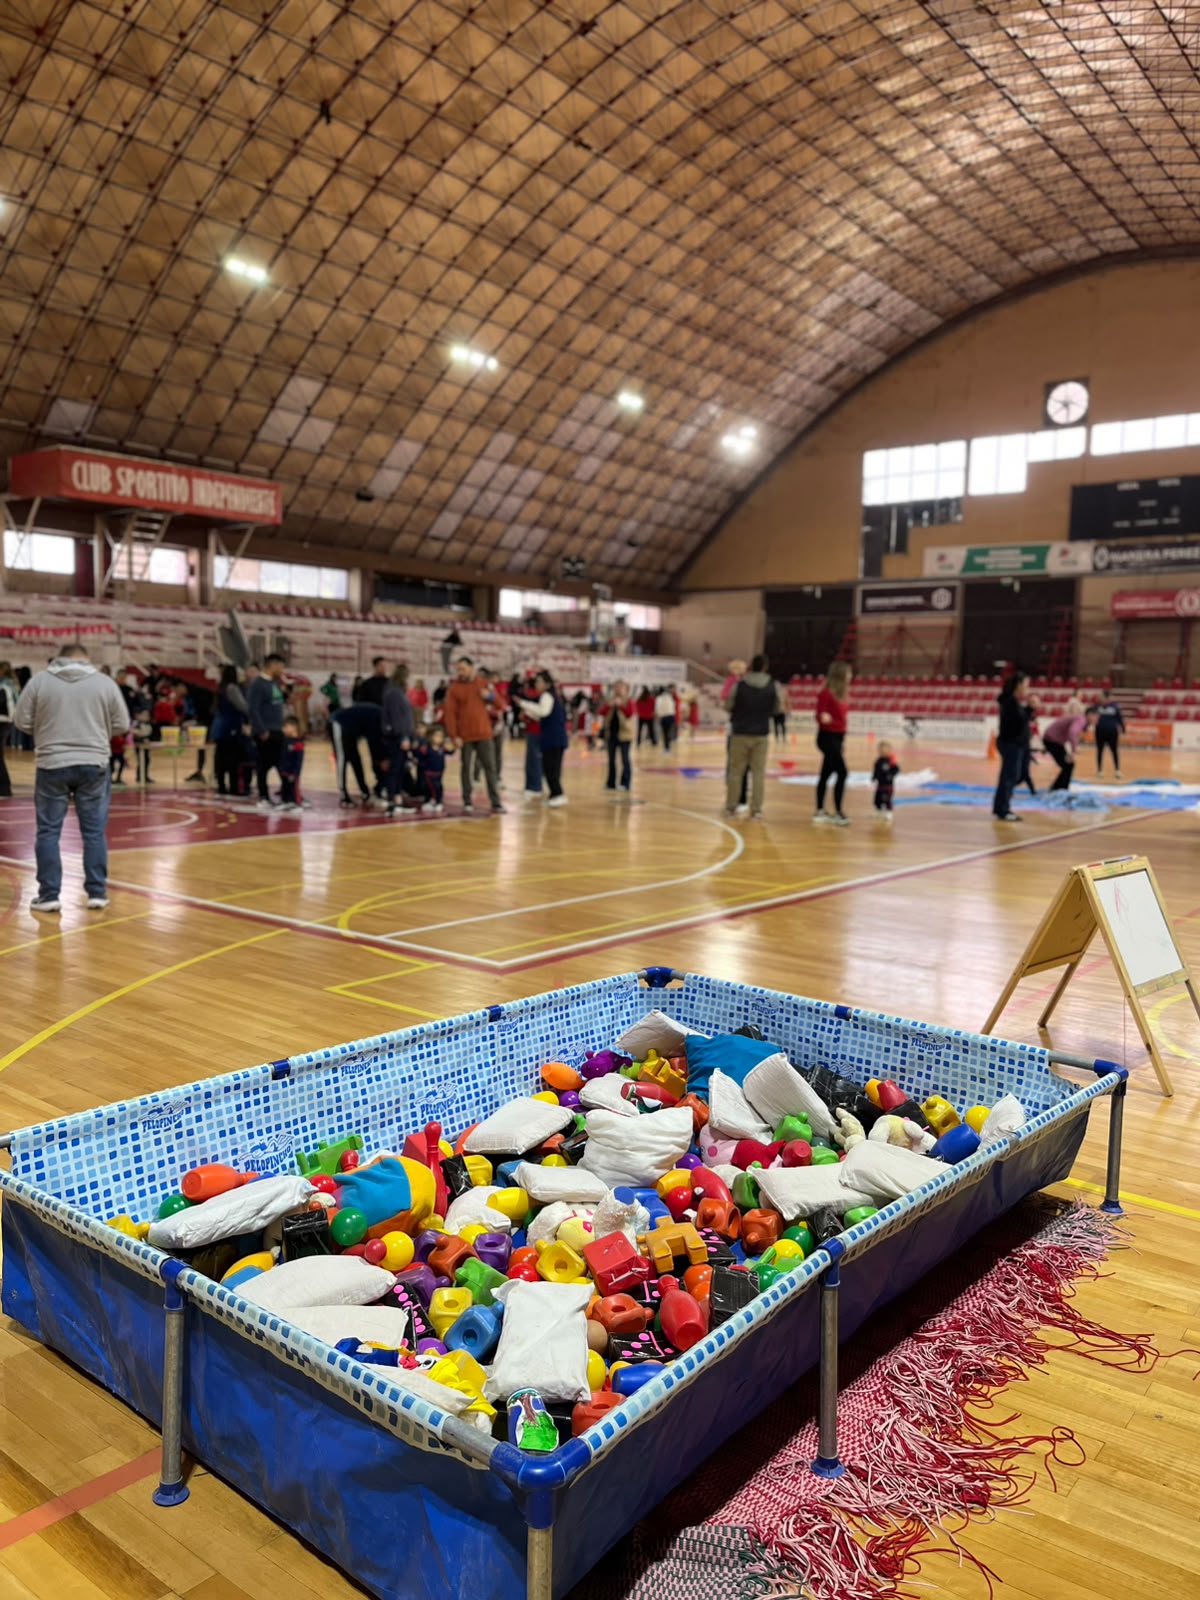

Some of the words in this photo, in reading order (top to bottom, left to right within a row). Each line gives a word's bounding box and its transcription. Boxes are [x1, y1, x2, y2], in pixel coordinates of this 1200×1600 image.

[71, 459, 112, 494] CLUB
[116, 466, 190, 504] SPORTIVO
[244, 1145, 292, 1173] PELOPINCHO
